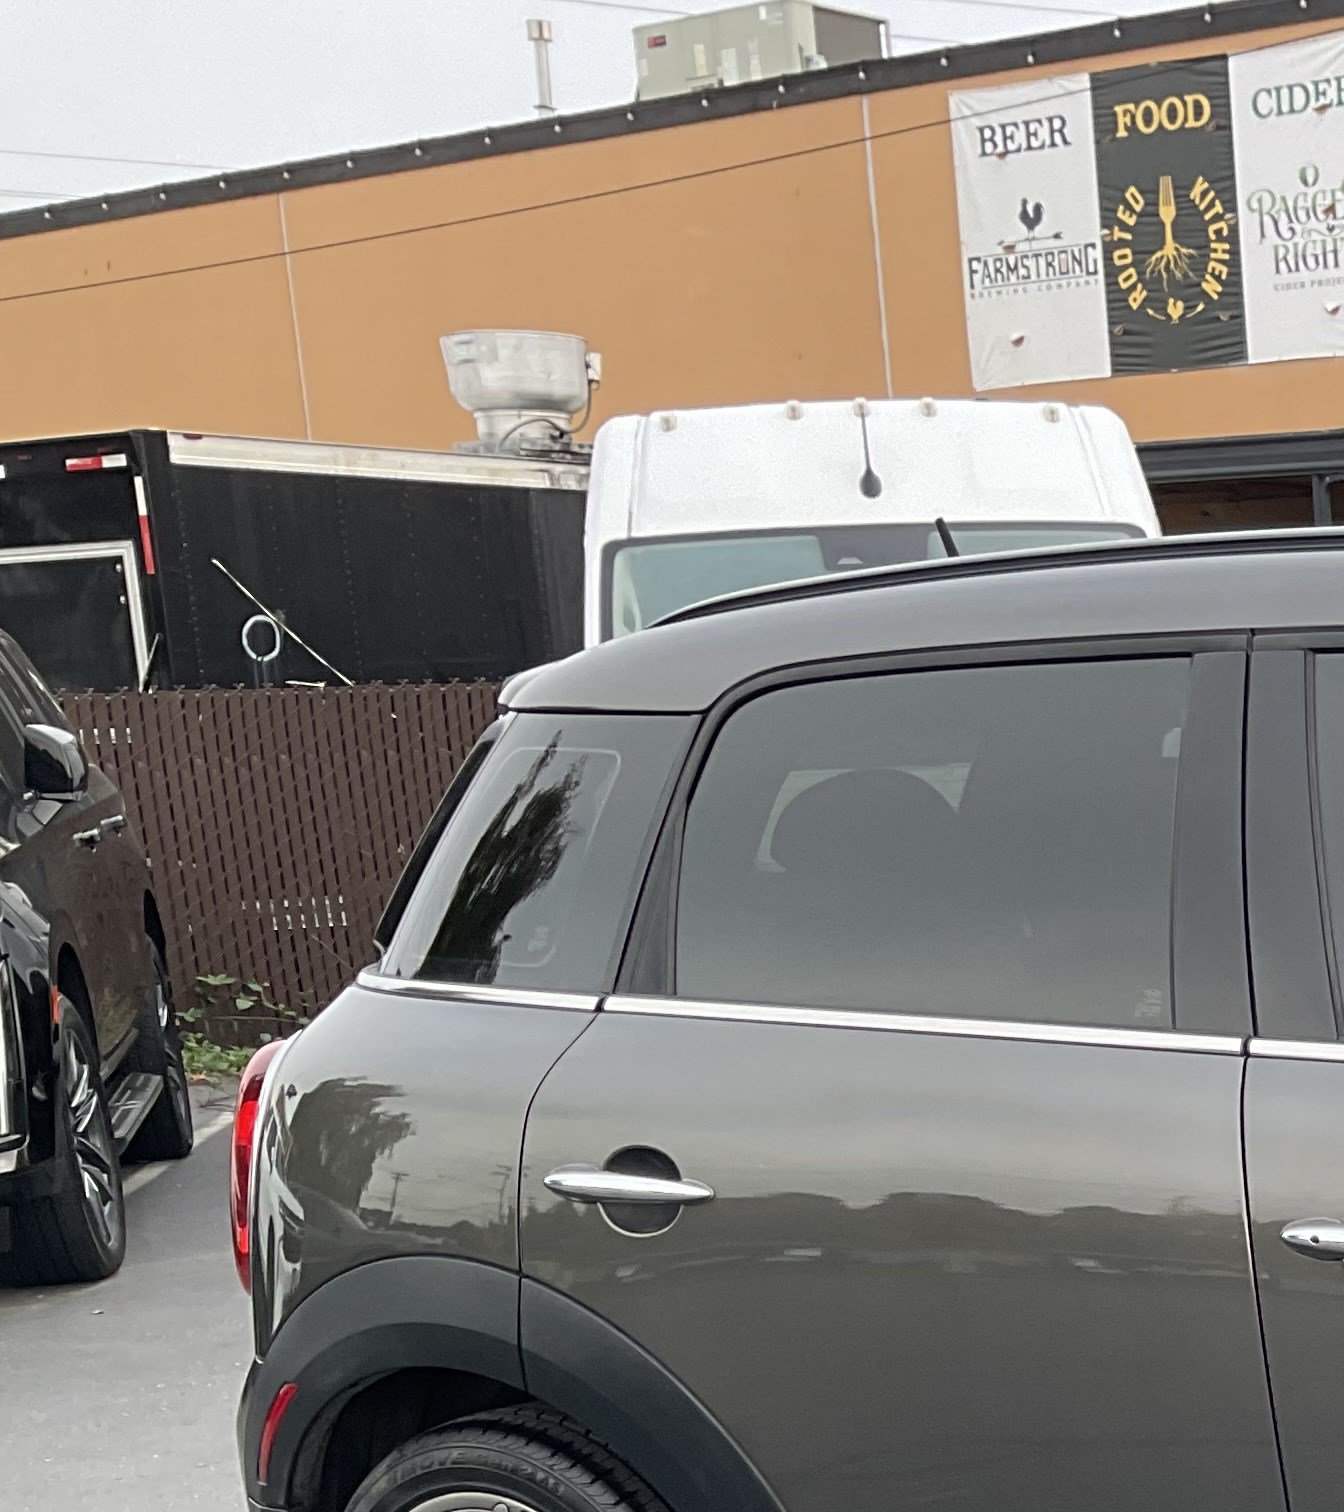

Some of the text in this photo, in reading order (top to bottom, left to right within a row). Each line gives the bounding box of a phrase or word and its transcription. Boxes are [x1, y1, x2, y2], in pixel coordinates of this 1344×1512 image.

[976, 114, 1073, 158] BEER
[1114, 94, 1211, 138] FOOD
[1113, 185, 1148, 311] ROOTED
[1189, 175, 1231, 301] KITCHEN
[968, 243, 1099, 290] FARMSTRONG
